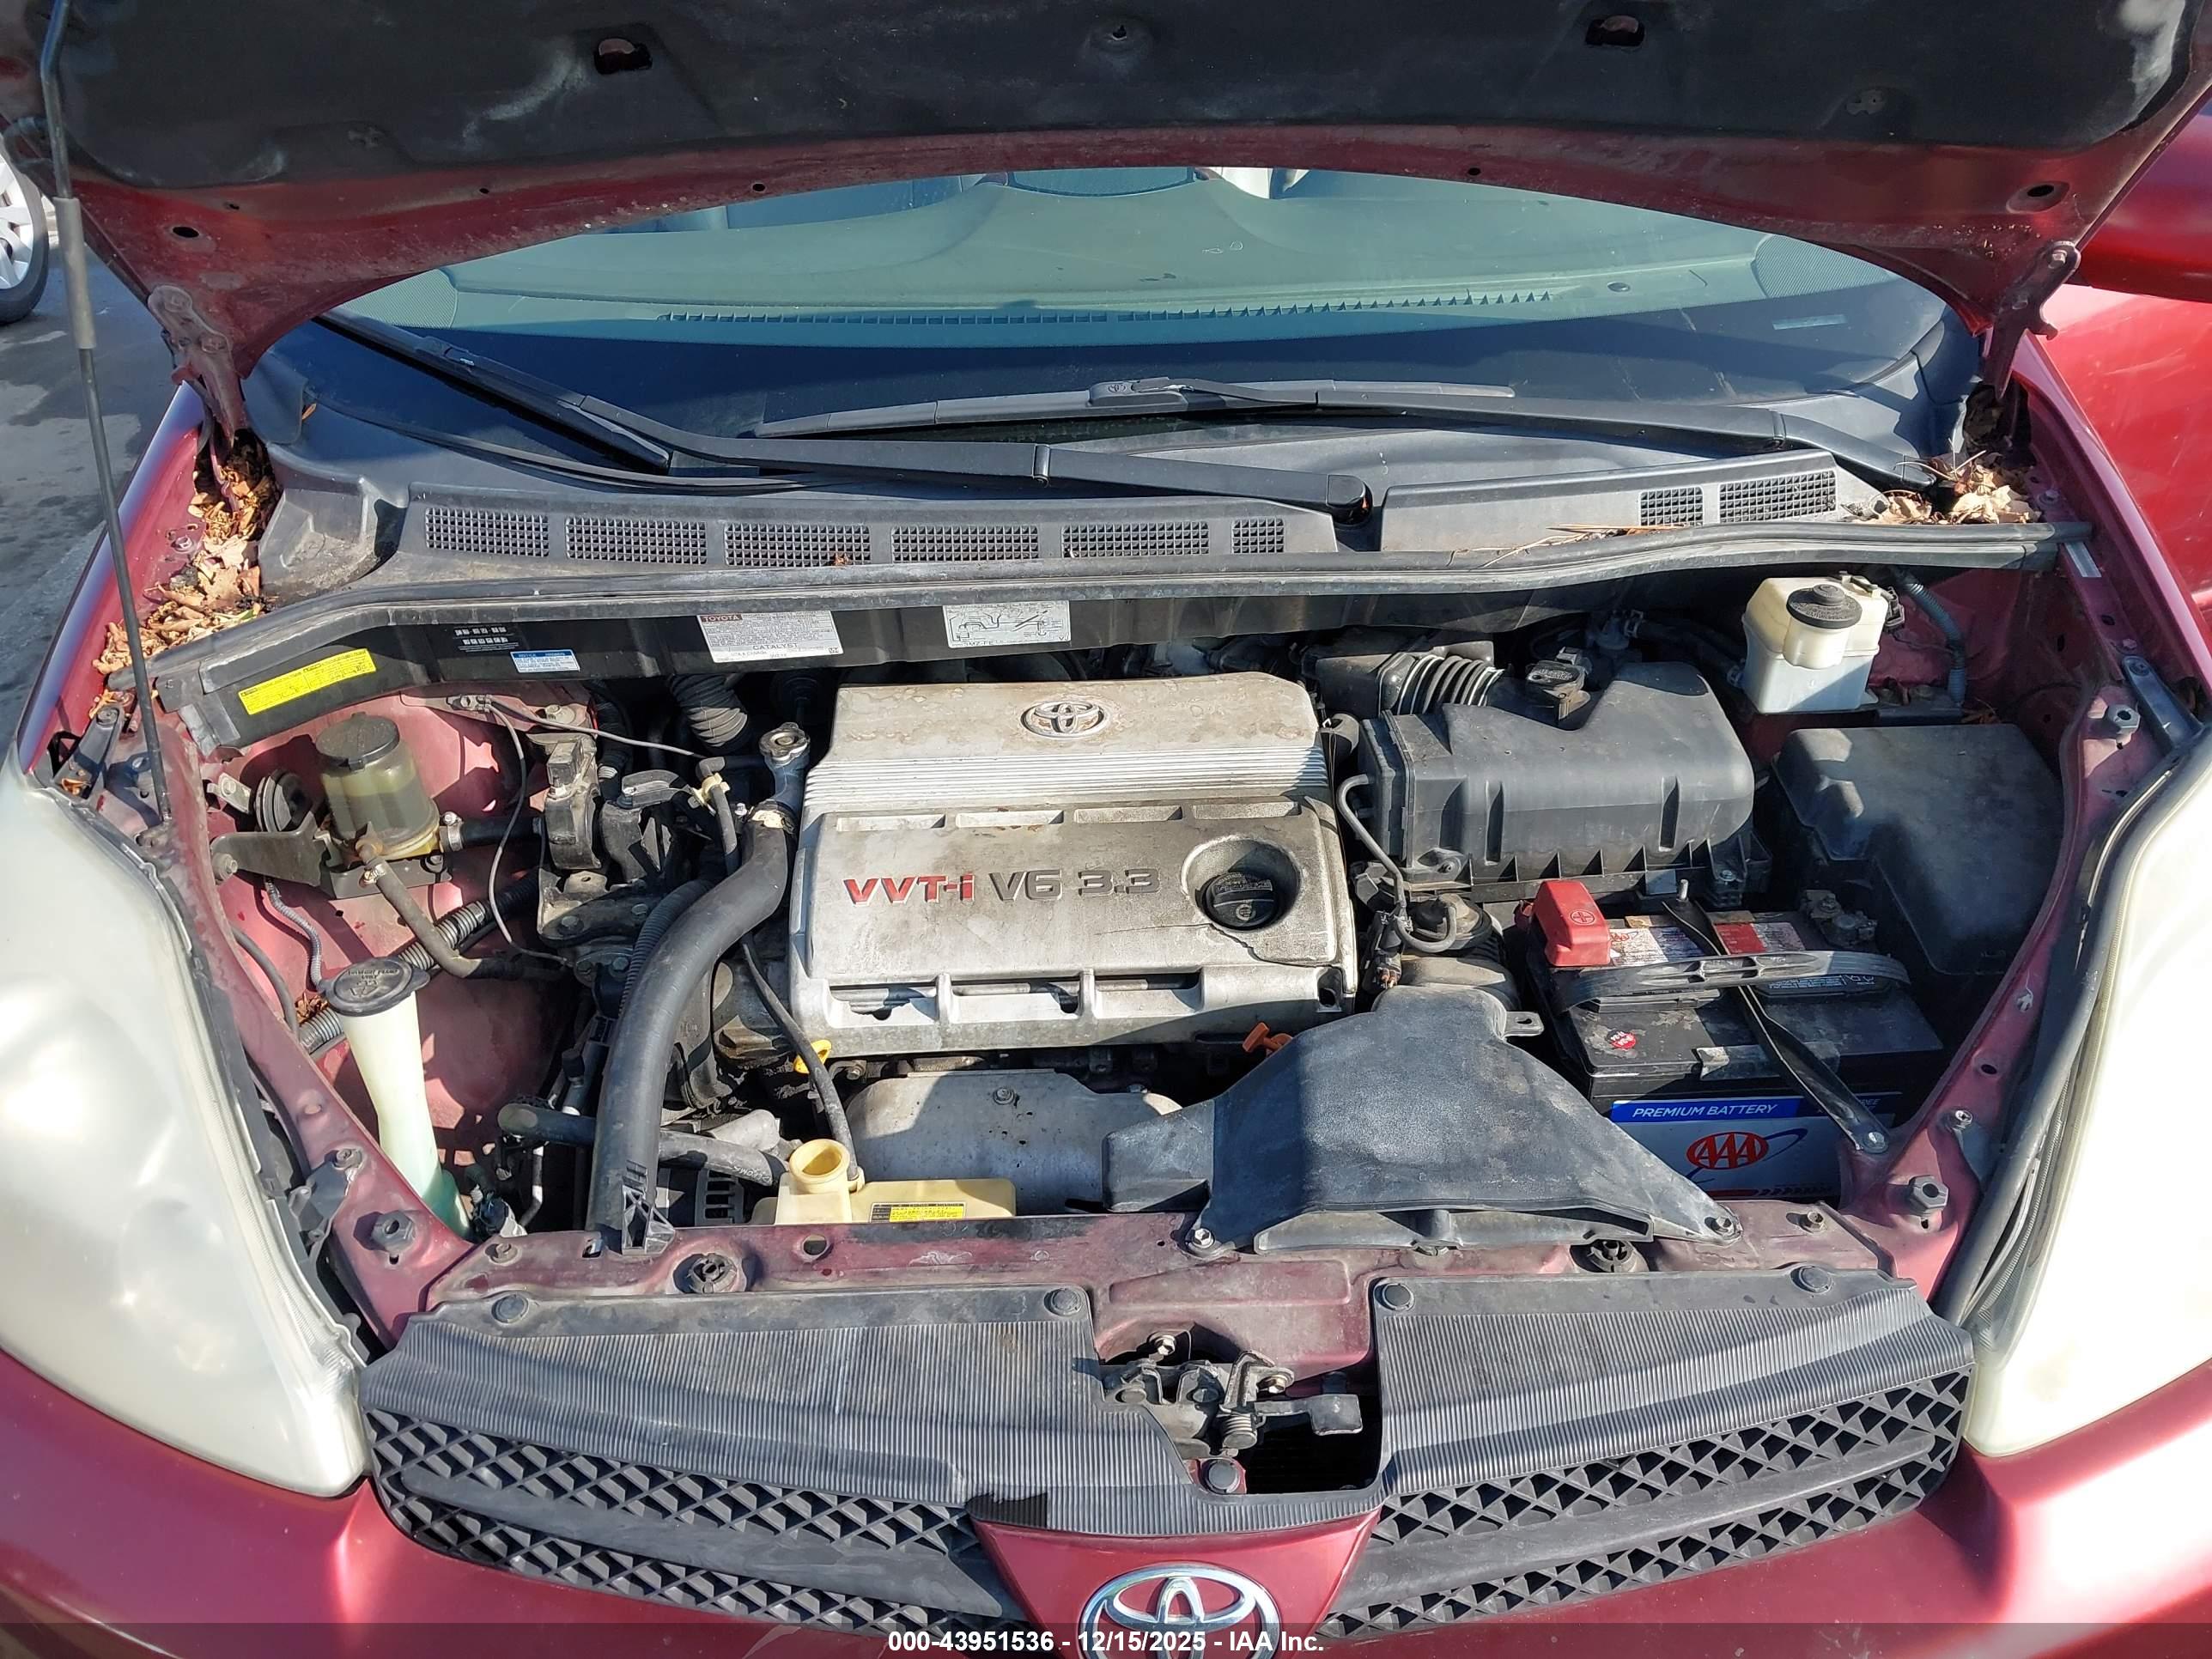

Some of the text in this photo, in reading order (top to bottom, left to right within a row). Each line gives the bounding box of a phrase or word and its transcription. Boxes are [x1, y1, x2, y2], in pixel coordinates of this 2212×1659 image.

[752, 642, 799, 651] CATALYST
[844, 869, 1161, 905] VVT-i V6 3.3
[1632, 1104, 1778, 1117] PREMIUM BATTERY
[1687, 1132, 1768, 1170] AAA
